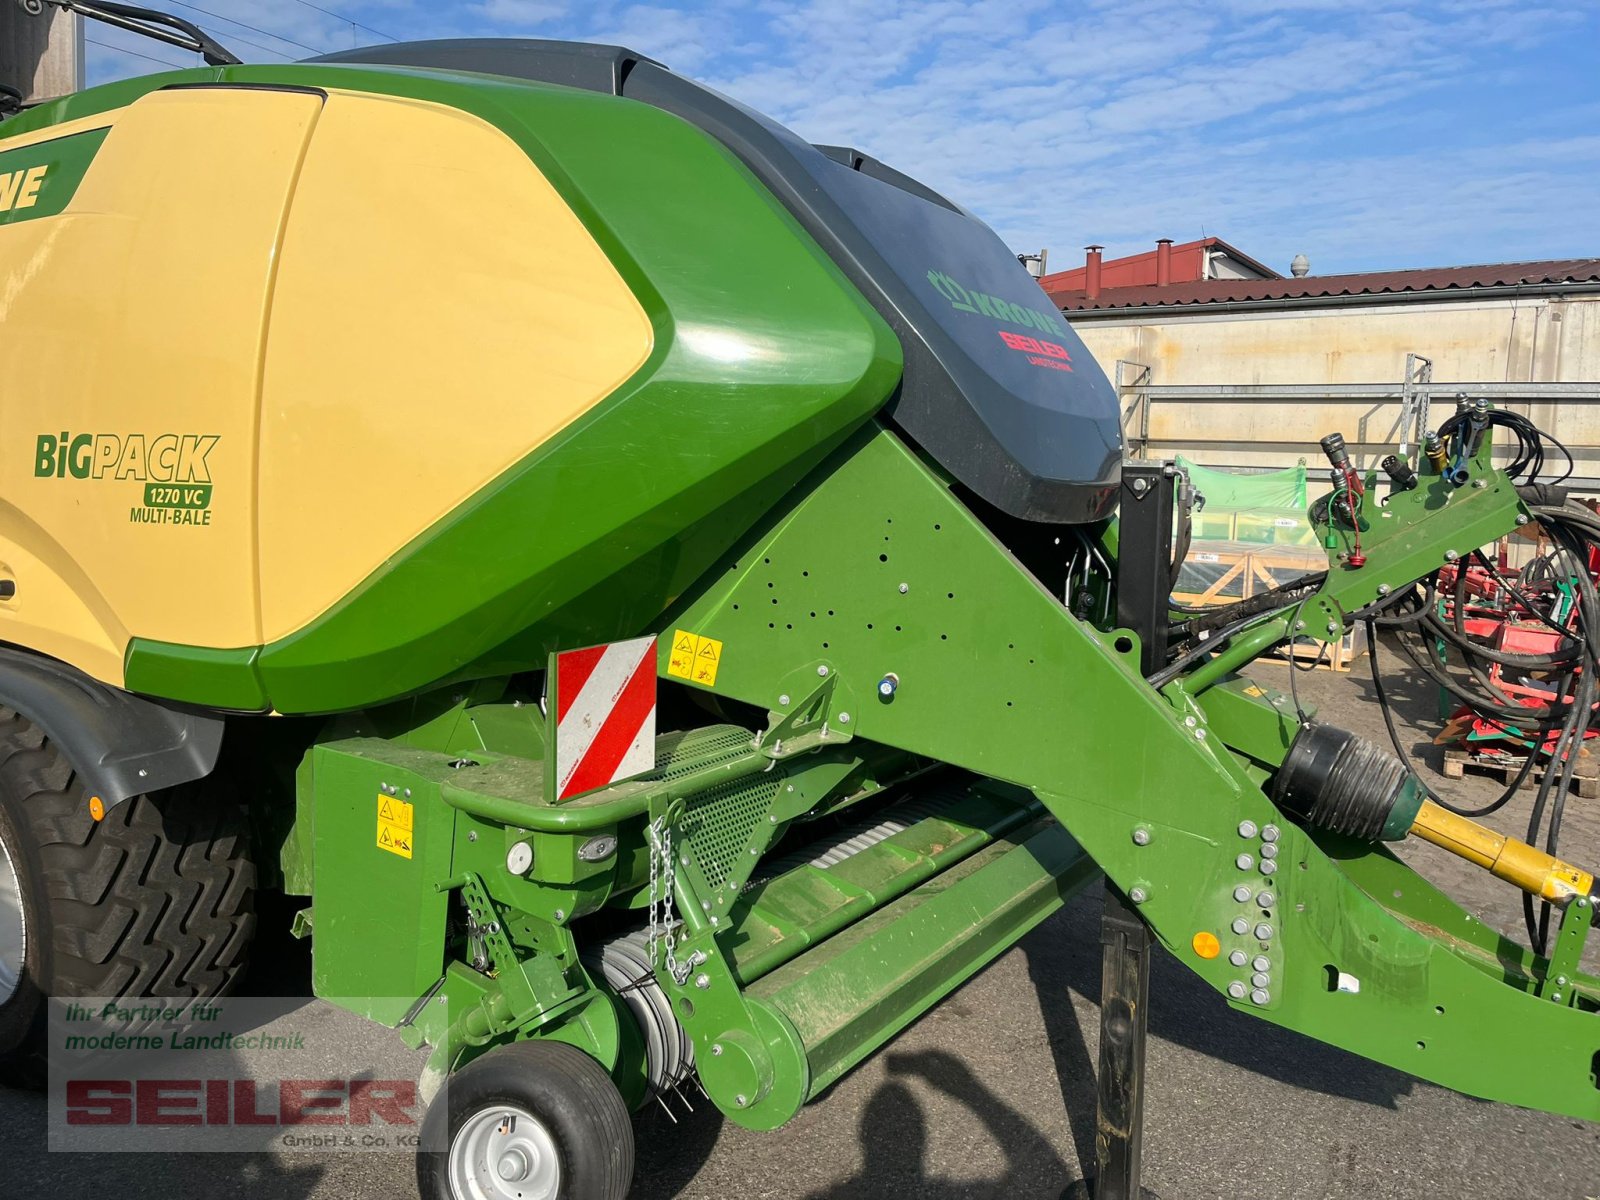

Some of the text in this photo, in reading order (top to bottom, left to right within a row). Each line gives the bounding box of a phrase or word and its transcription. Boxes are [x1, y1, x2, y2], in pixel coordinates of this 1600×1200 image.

[969, 290, 1066, 338] KRONE
[998, 331, 1072, 361] SEILER
[150, 488, 203, 505] 1270 VC
[130, 508, 212, 526] MULTI-BALE
